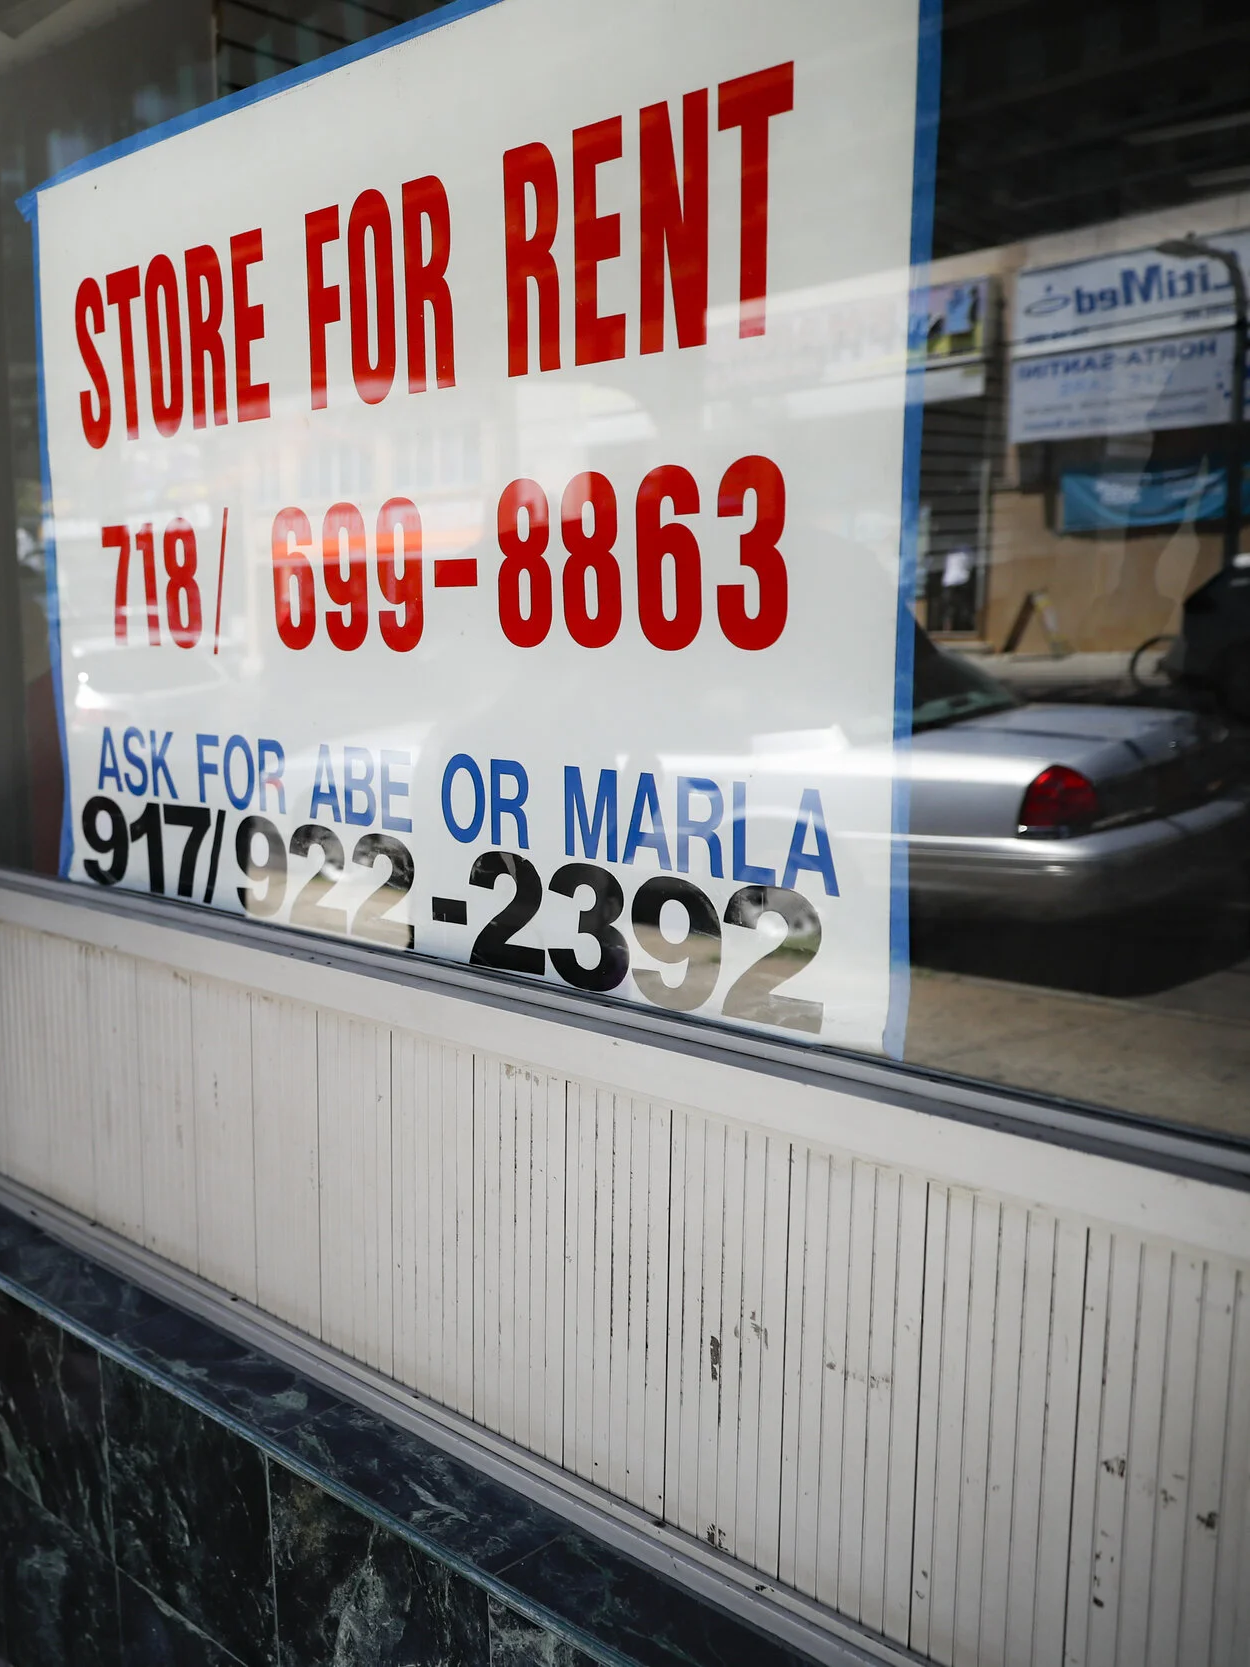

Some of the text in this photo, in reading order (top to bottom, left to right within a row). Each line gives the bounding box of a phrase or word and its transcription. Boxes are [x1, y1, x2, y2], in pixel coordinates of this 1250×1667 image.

[74, 61, 795, 450] STORE FOR RENT
[271, 455, 789, 653] 699-8863
[98, 726, 841, 897] ASK FOR ABE OR MARLA
